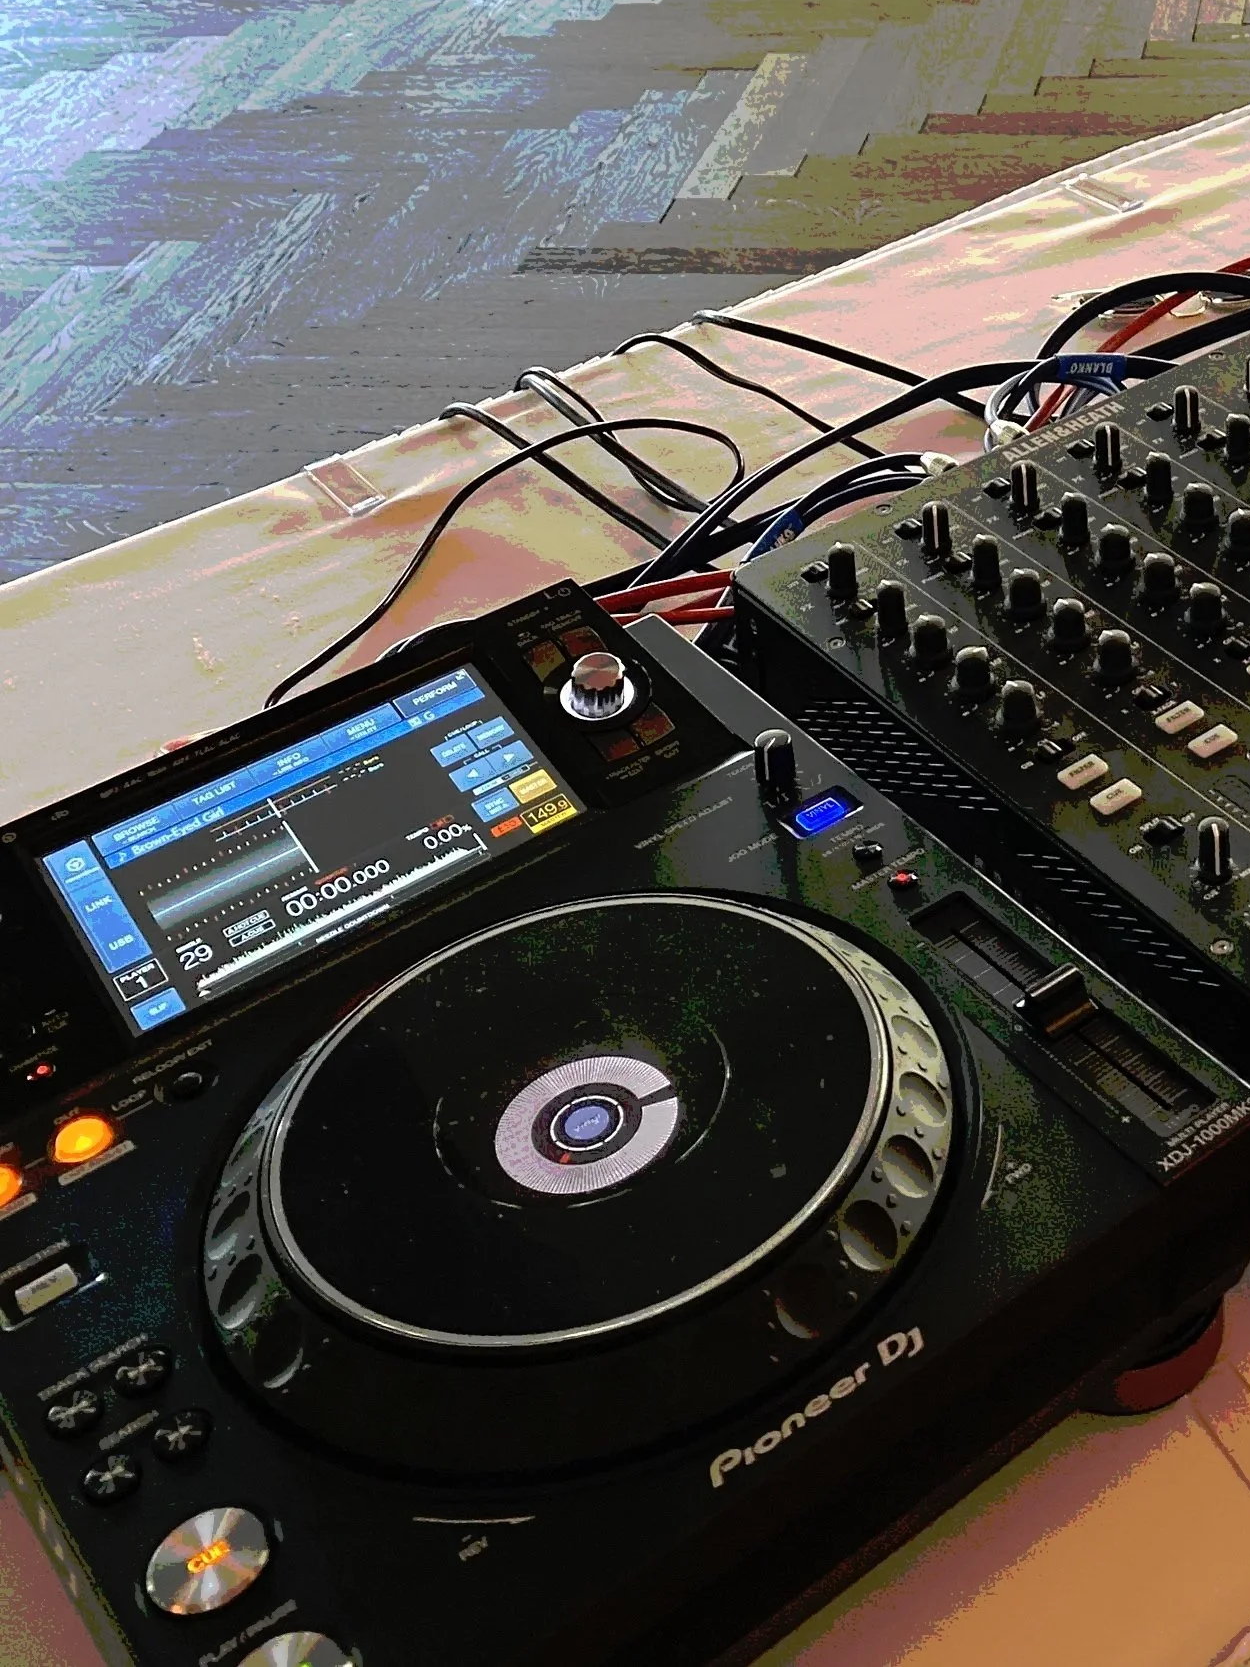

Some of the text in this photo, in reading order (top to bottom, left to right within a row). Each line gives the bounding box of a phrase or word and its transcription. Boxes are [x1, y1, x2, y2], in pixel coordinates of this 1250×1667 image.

[412, 681, 458, 706] PERFORM
[424, 711, 435, 721] G
[1165, 707, 1191, 723] FILTER
[346, 718, 376, 736] MENU
[276, 752, 302, 768] INFO
[1069, 760, 1095, 778] FILTER
[191, 781, 237, 806] TAG LIST
[527, 799, 569, 825] 149.9
[698, 796, 735, 818] ADJUST
[804, 801, 835, 820] VINYL
[113, 816, 160, 842] BROWSE
[131, 807, 225, 856] Brown-Eyed Girl
[423, 823, 473, 850] 0.00%
[851, 847, 925, 891] MASTER TEMPO
[285, 859, 390, 918] 00:00.000
[84, 895, 113, 914] LINK
[108, 934, 134, 951] USB
[179, 944, 213, 971] 29
[119, 963, 155, 984] PLAYER
[136, 975, 149, 989] 1
[111, 1089, 147, 1111] LOOP
[709, 1361, 871, 1489] Pioneer
[186, 1539, 231, 1574] CUE
